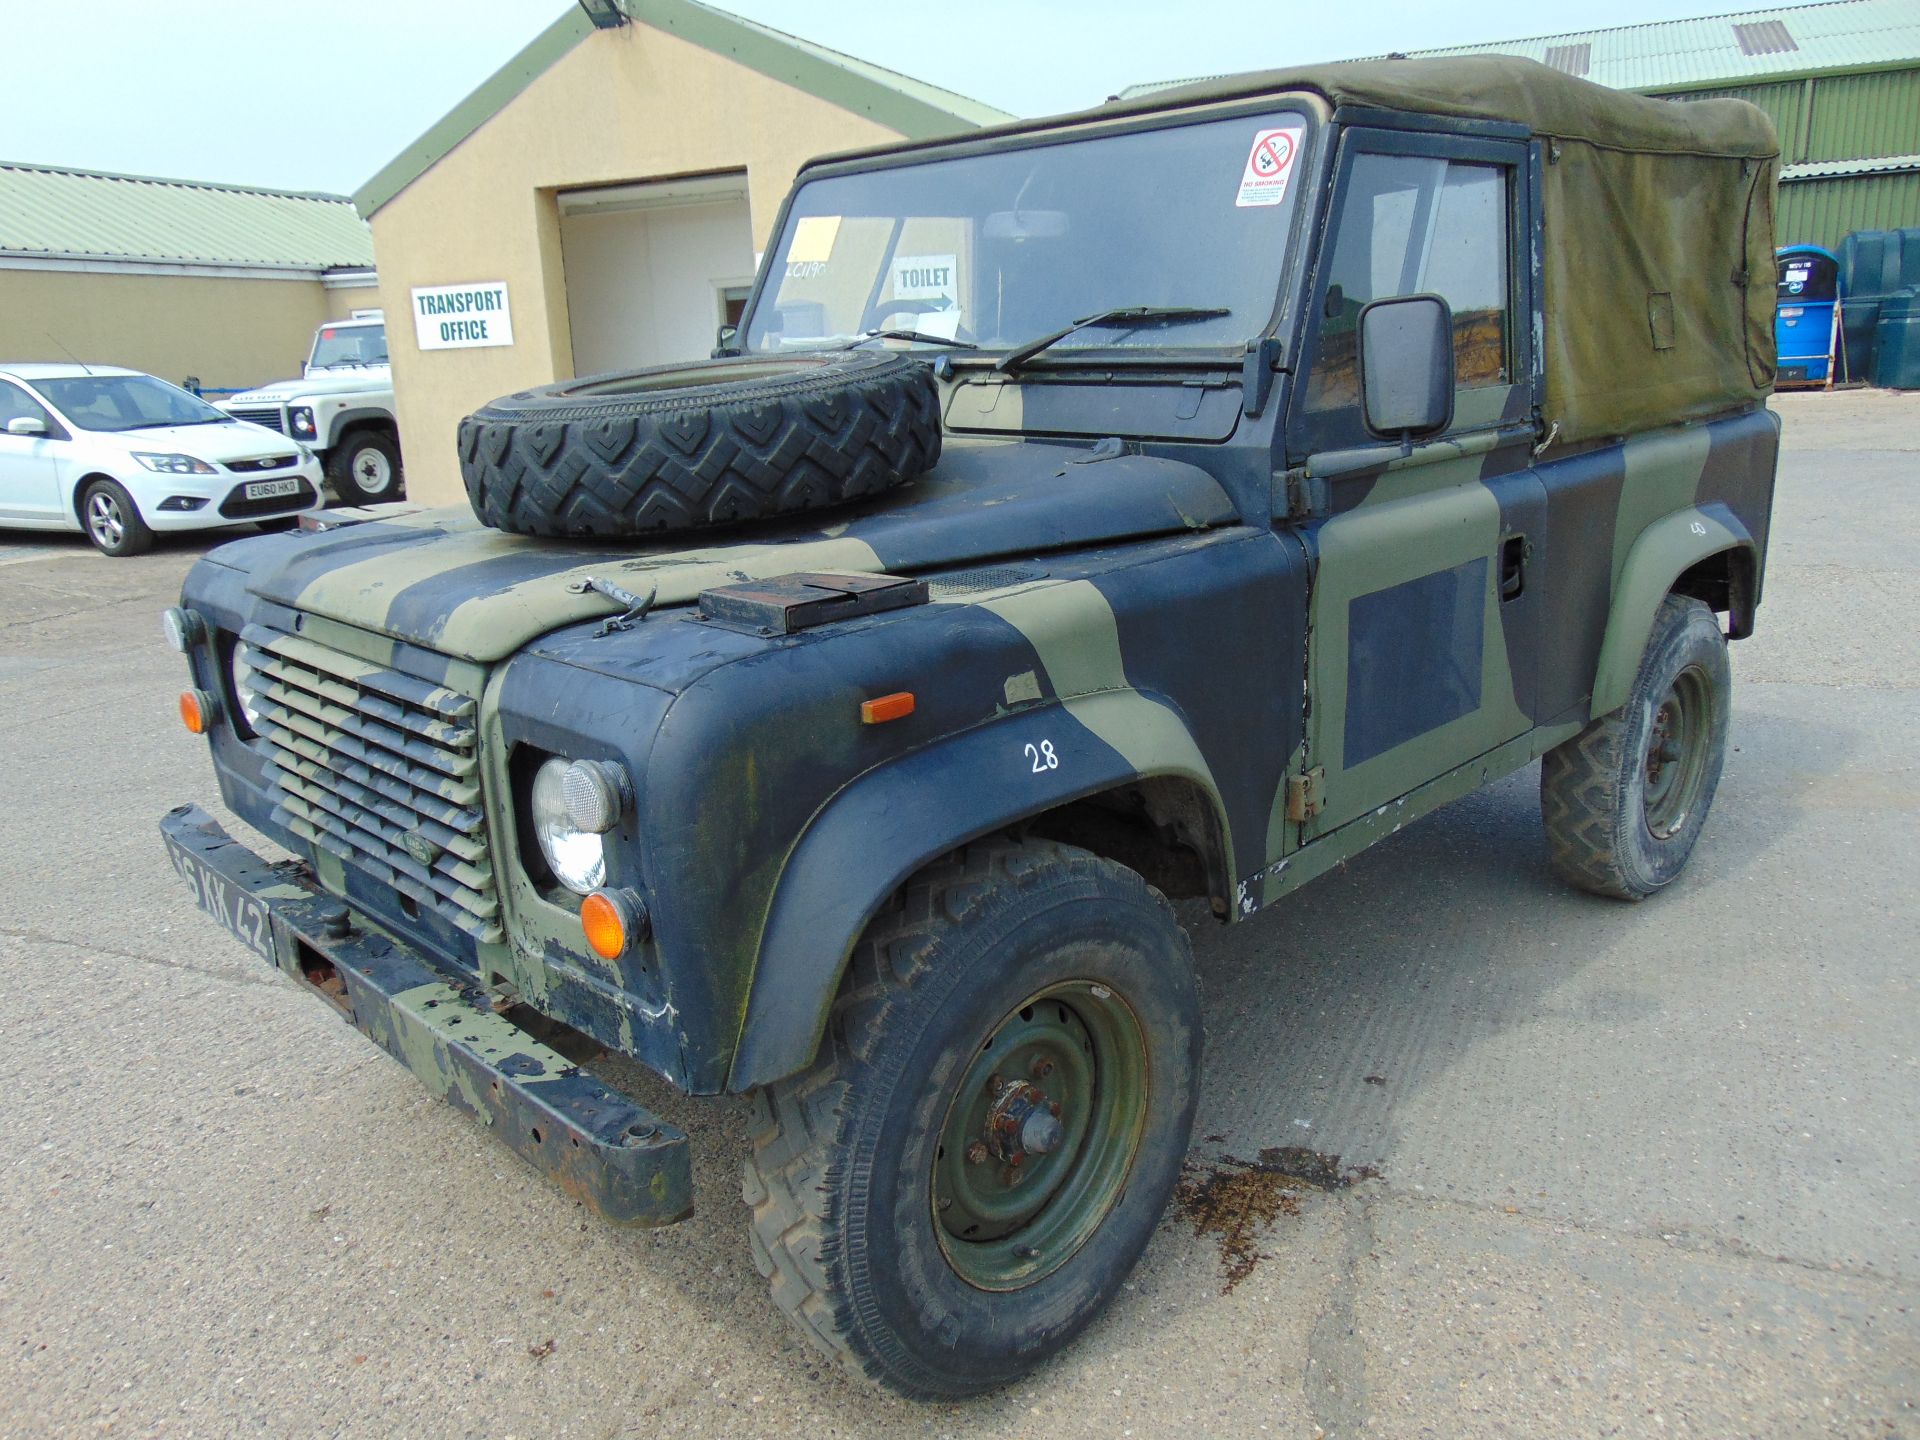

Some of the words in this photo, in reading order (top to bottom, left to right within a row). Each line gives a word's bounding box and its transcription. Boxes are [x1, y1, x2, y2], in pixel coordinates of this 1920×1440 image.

[901, 267, 949, 288] TOILET
[417, 290, 502, 315] TRANSPORT
[440, 319, 488, 342] OFFICE
[250, 483, 276, 497] EU60
[1024, 739, 1058, 774] 28
[236, 896, 268, 956] 42
